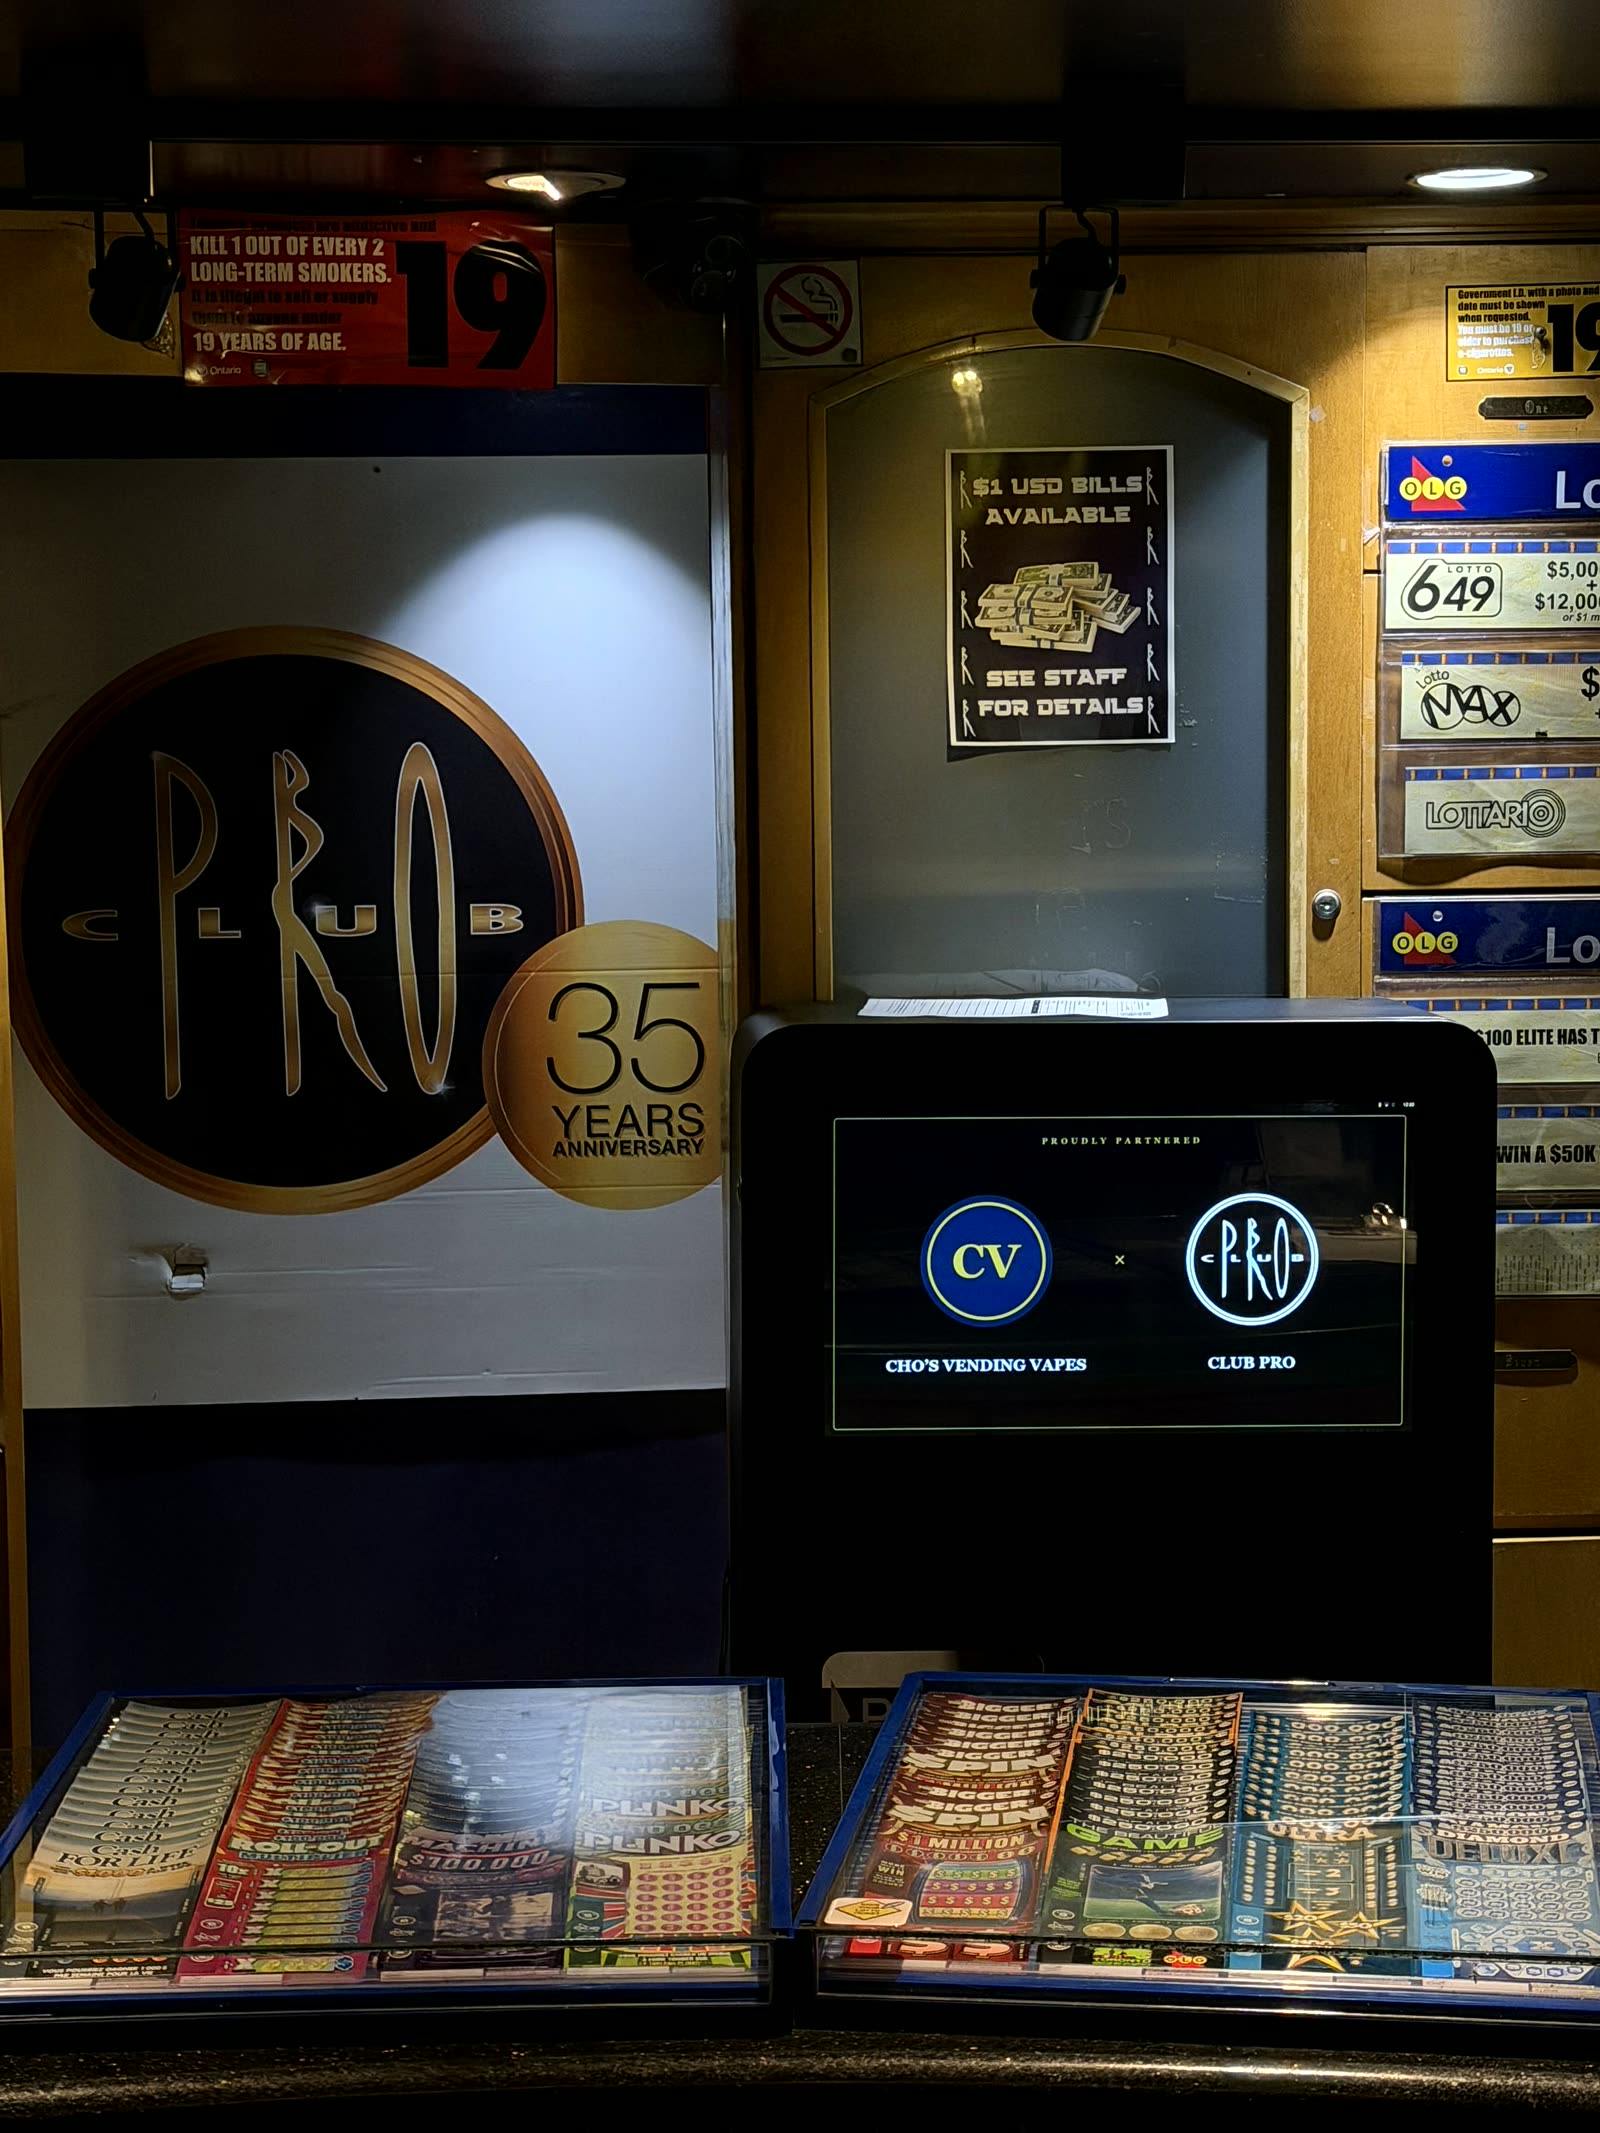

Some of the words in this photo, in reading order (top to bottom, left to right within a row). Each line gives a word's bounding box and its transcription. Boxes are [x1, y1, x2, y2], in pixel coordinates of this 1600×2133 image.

[190, 235, 228, 255] KILL
[231, 235, 241, 255] 1
[245, 236, 282, 256] OUT
[285, 236, 309, 256] OF
[312, 236, 368, 256] EVERY
[371, 238, 384, 257] 2
[191, 261, 294, 283] LONG-TERM
[298, 262, 392, 283] SMOKERS.
[1458, 289, 1512, 300] Government
[1527, 287, 1548, 297] with
[1548, 289, 1555, 297] a
[1556, 286, 1582, 298] photo
[1583, 286, 1600, 296] and
[396, 239, 547, 370] 19
[1458, 301, 1478, 311] date
[1479, 301, 1502, 311] must
[1503, 300, 1515, 310] be
[1516, 300, 1545, 310] shown
[1458, 313, 1482, 323] when
[1484, 311, 1531, 323] requested.
[1457, 324, 1474, 335] You
[1475, 323, 1498, 334] must
[193, 332, 215, 351] 19
[218, 332, 277, 351] YEARS
[281, 332, 304, 351] OF
[307, 332, 347, 351] AGE.
[210, 366, 242, 376] Ontario
[1524, 400, 1549, 415] One
[972, 477, 1003, 497] $1
[1011, 477, 1063, 495] USD
[1071, 475, 1142, 494] BILLS
[1402, 480, 1464, 497] OLG
[985, 506, 1131, 525] AVAILABLE
[1447, 565, 1493, 574] LOTTO
[986, 670, 1036, 687] SEE
[1044, 668, 1128, 686] STAFF
[1415, 670, 1450, 690] Lotto
[977, 698, 1029, 717] FOR
[1036, 697, 1144, 716] DETAILS
[1421, 683, 1521, 730] MAX
[1426, 789, 1566, 838] LOTTARIO
[62, 903, 524, 941] CLUB
[154, 742, 457, 1100] PRO
[1395, 934, 1456, 951] OLG
[546, 982, 705, 1095] 35
[1516, 1029, 1553, 1046] ELITE
[1557, 1028, 1588, 1045] HAS
[551, 1103, 705, 1139] YEARS
[553, 1138, 705, 1158] ANNIVERSARY
[1041, 1136, 1107, 1145] PROUDLY
[1115, 1136, 1201, 1145] PARTNERED
[1496, 1145, 1531, 1163] WIN
[1535, 1145, 1546, 1163] A
[1550, 1144, 1596, 1165] $50K
[952, 1243, 1022, 1279] CV
[1221, 1217, 1290, 1301] PRO
[885, 1359, 939, 1373] CHO'S
[942, 1358, 1026, 1372] VENDING
[1029, 1358, 1087, 1372] VAPES
[1207, 1356, 1255, 1370] CLUB
[1258, 1356, 1296, 1369] PRO
[958, 1699, 1055, 1713] BIGGER
[948, 1727, 1044, 1740] BIGGER
[943, 1738, 1041, 1750] BIGGER
[937, 1748, 1036, 1760] BIGGER
[112, 1795, 178, 1807] Cash
[928, 1787, 1030, 1800] BIGGER
[108, 1807, 176, 1819] Cash
[925, 1799, 1028, 1813] BIGGER
[94, 1830, 163, 1842] Cash
[1066, 1822, 1225, 1850] GAME
[1267, 1822, 1377, 1842] ULTRA
[1436, 1828, 1570, 1844] DIAMOND
[91, 1843, 160, 1856] Cash
[583, 1830, 742, 1854] PLINKO
[928, 1833, 1025, 1850] MILLION
[57, 1852, 122, 1868] FOR
[128, 1845, 198, 1867] LIFE
